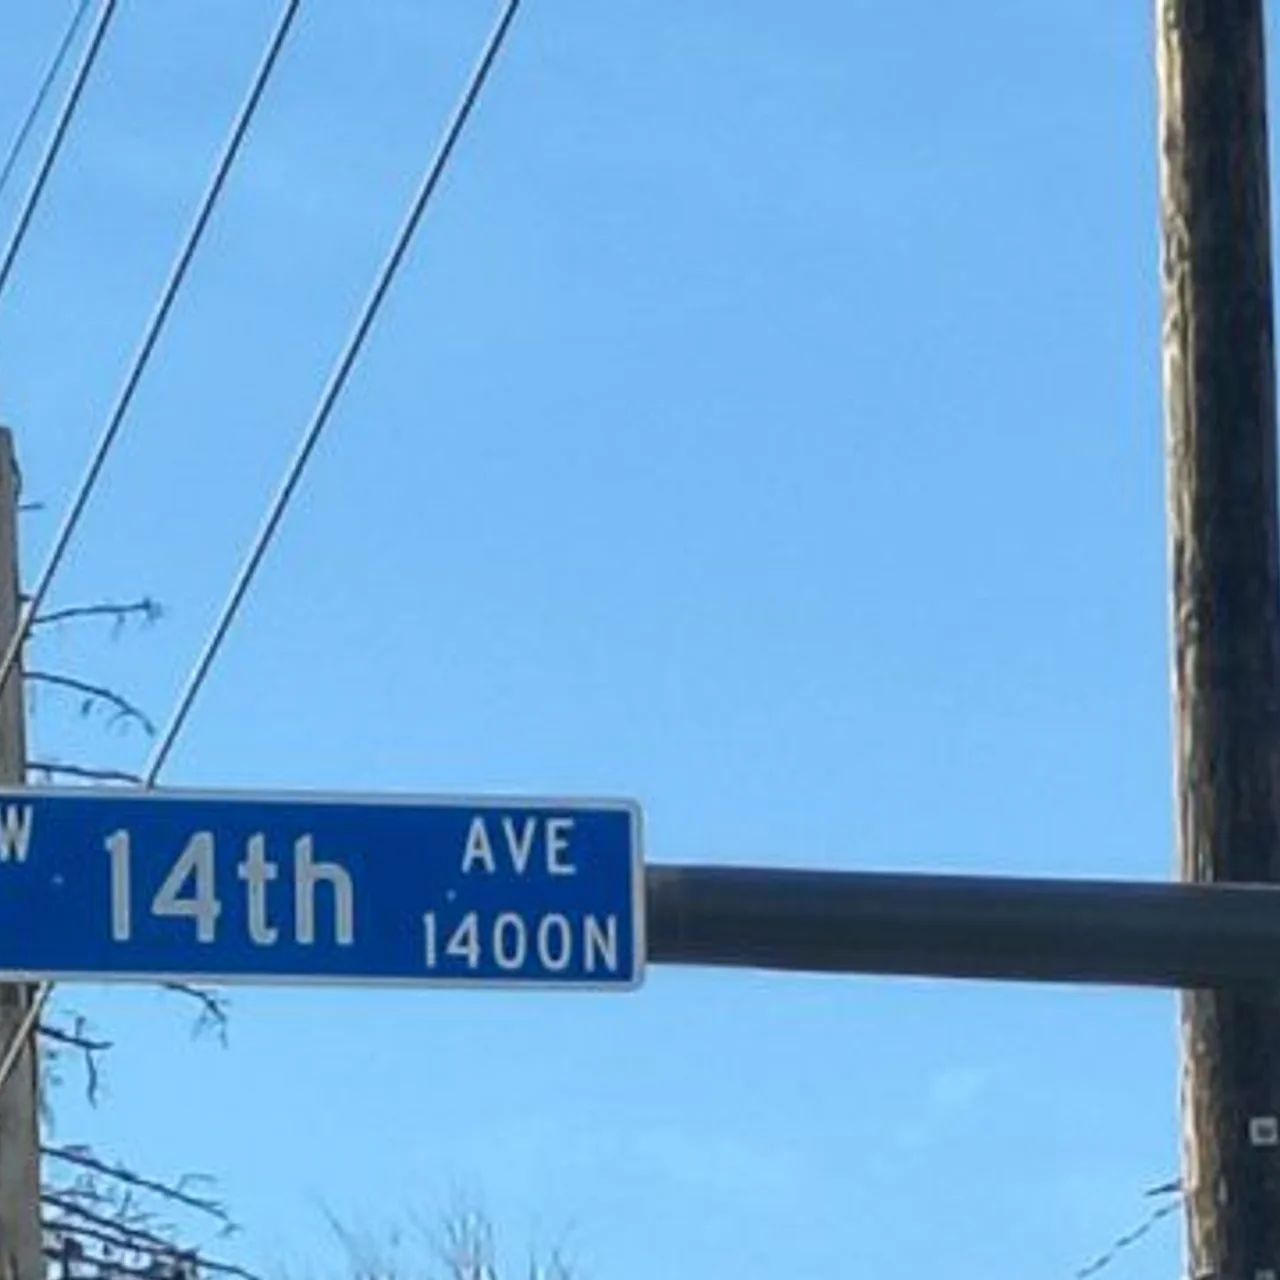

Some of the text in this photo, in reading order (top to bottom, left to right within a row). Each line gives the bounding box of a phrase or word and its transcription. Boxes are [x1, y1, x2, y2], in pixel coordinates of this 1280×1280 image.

[104, 831, 354, 945] 14th
[463, 817, 577, 875] AVE
[423, 911, 618, 971] 1400N
